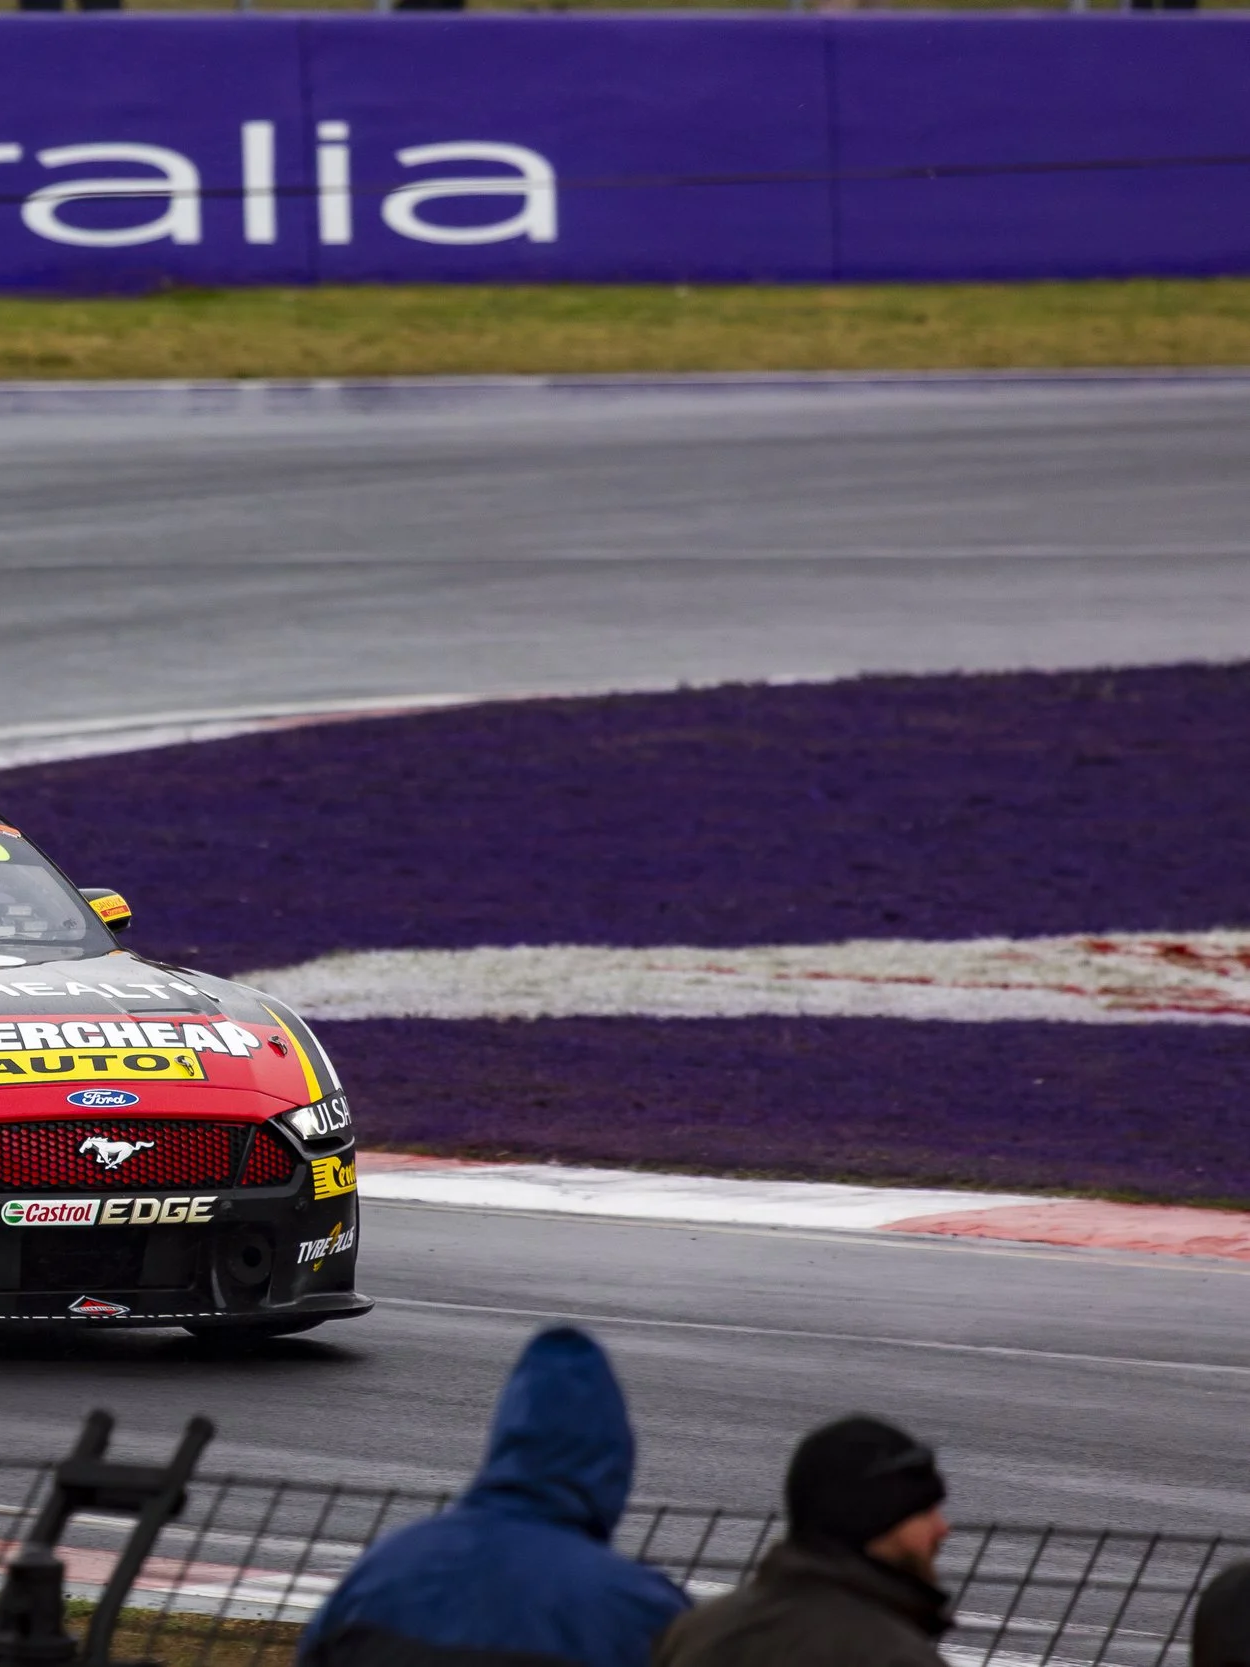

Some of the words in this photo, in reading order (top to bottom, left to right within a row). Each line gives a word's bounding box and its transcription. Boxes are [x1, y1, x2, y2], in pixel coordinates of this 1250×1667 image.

[82, 1089, 127, 1106] Ford
[25, 1203, 93, 1222] Castrol
[99, 1196, 219, 1225] EDGE
